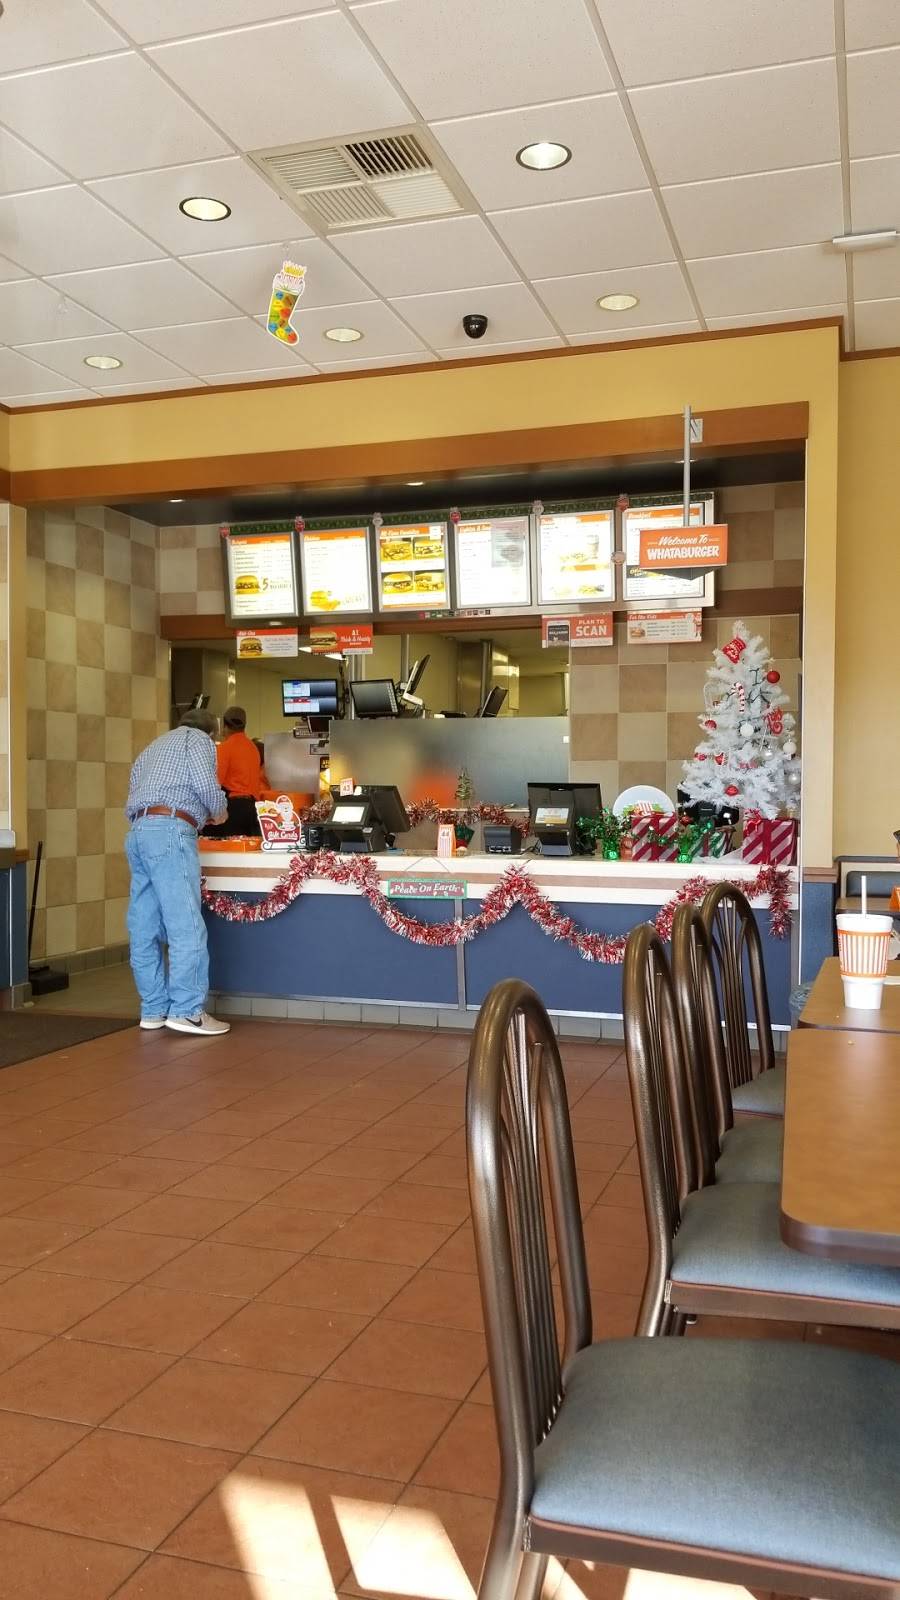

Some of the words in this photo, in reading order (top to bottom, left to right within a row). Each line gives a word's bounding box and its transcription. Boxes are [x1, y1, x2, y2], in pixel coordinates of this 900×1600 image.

[658, 536, 698, 546] Welcome
[698, 534, 710, 544] To
[648, 546, 720, 560] WHATABURGER
[576, 625, 608, 637] SCAN
[394, 884, 418, 894] Peace
[419, 884, 432, 893] On
[434, 882, 458, 892] Earth
